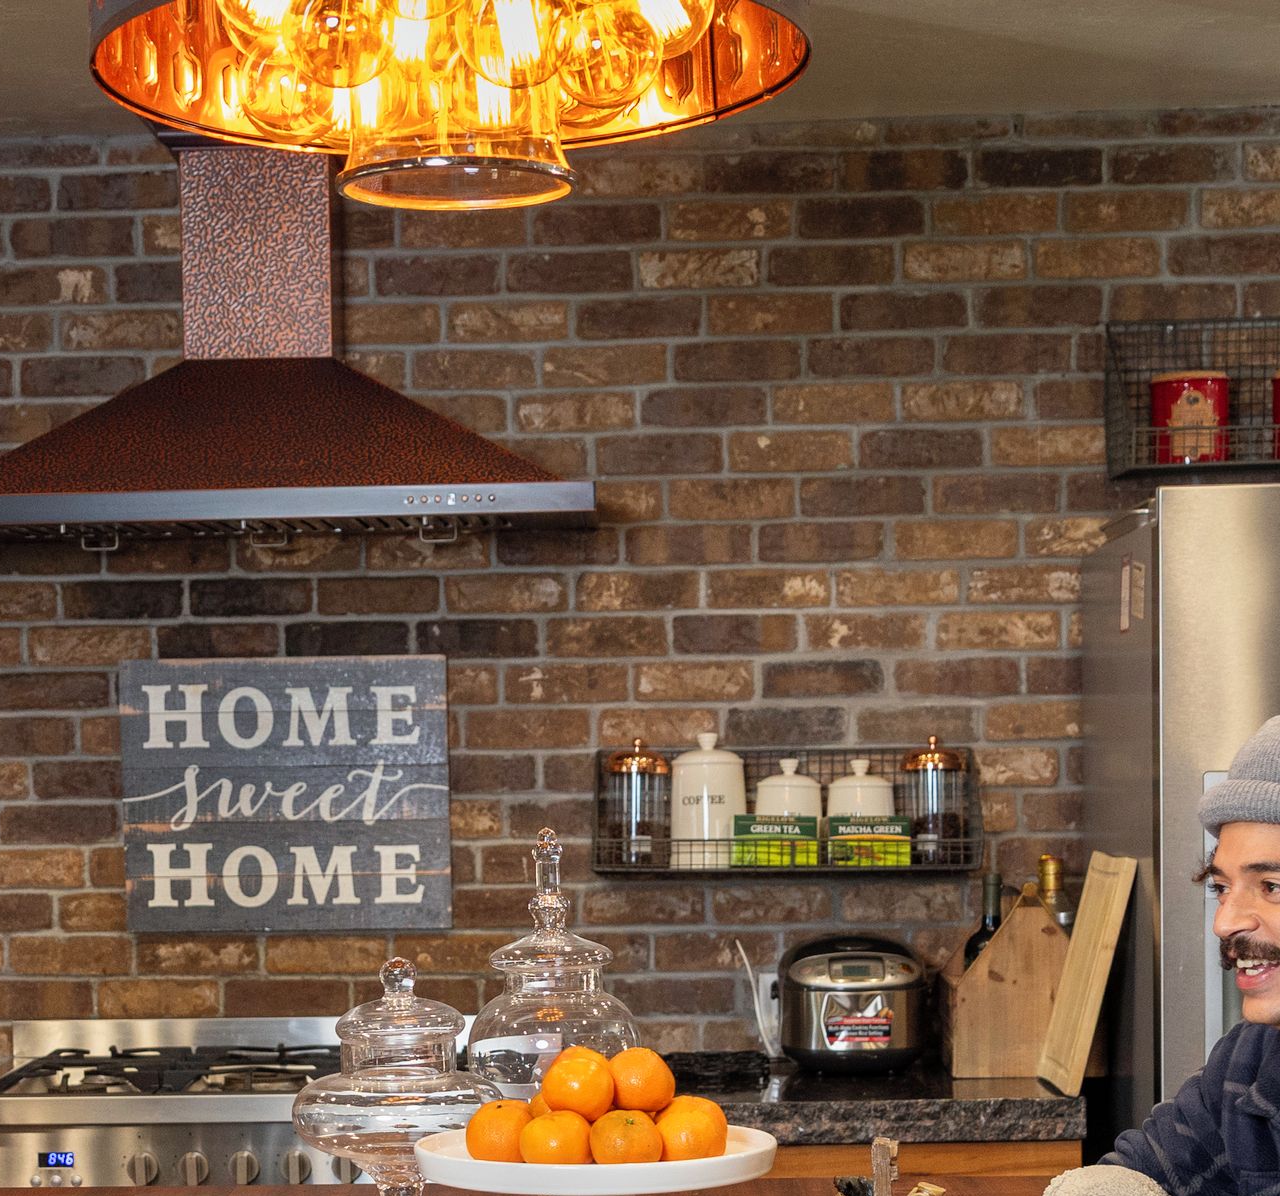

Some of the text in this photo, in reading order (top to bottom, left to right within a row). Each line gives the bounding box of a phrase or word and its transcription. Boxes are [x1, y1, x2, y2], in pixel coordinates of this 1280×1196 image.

[141, 684, 421, 750] HOME
[123, 759, 448, 832] sweet
[682, 794, 726, 806] COFEE
[750, 824, 801, 834] GREEN TEA
[838, 825, 902, 834] MATCHA GREEN
[146, 842, 425, 908] HOME
[48, 1152, 74, 1165] 846
